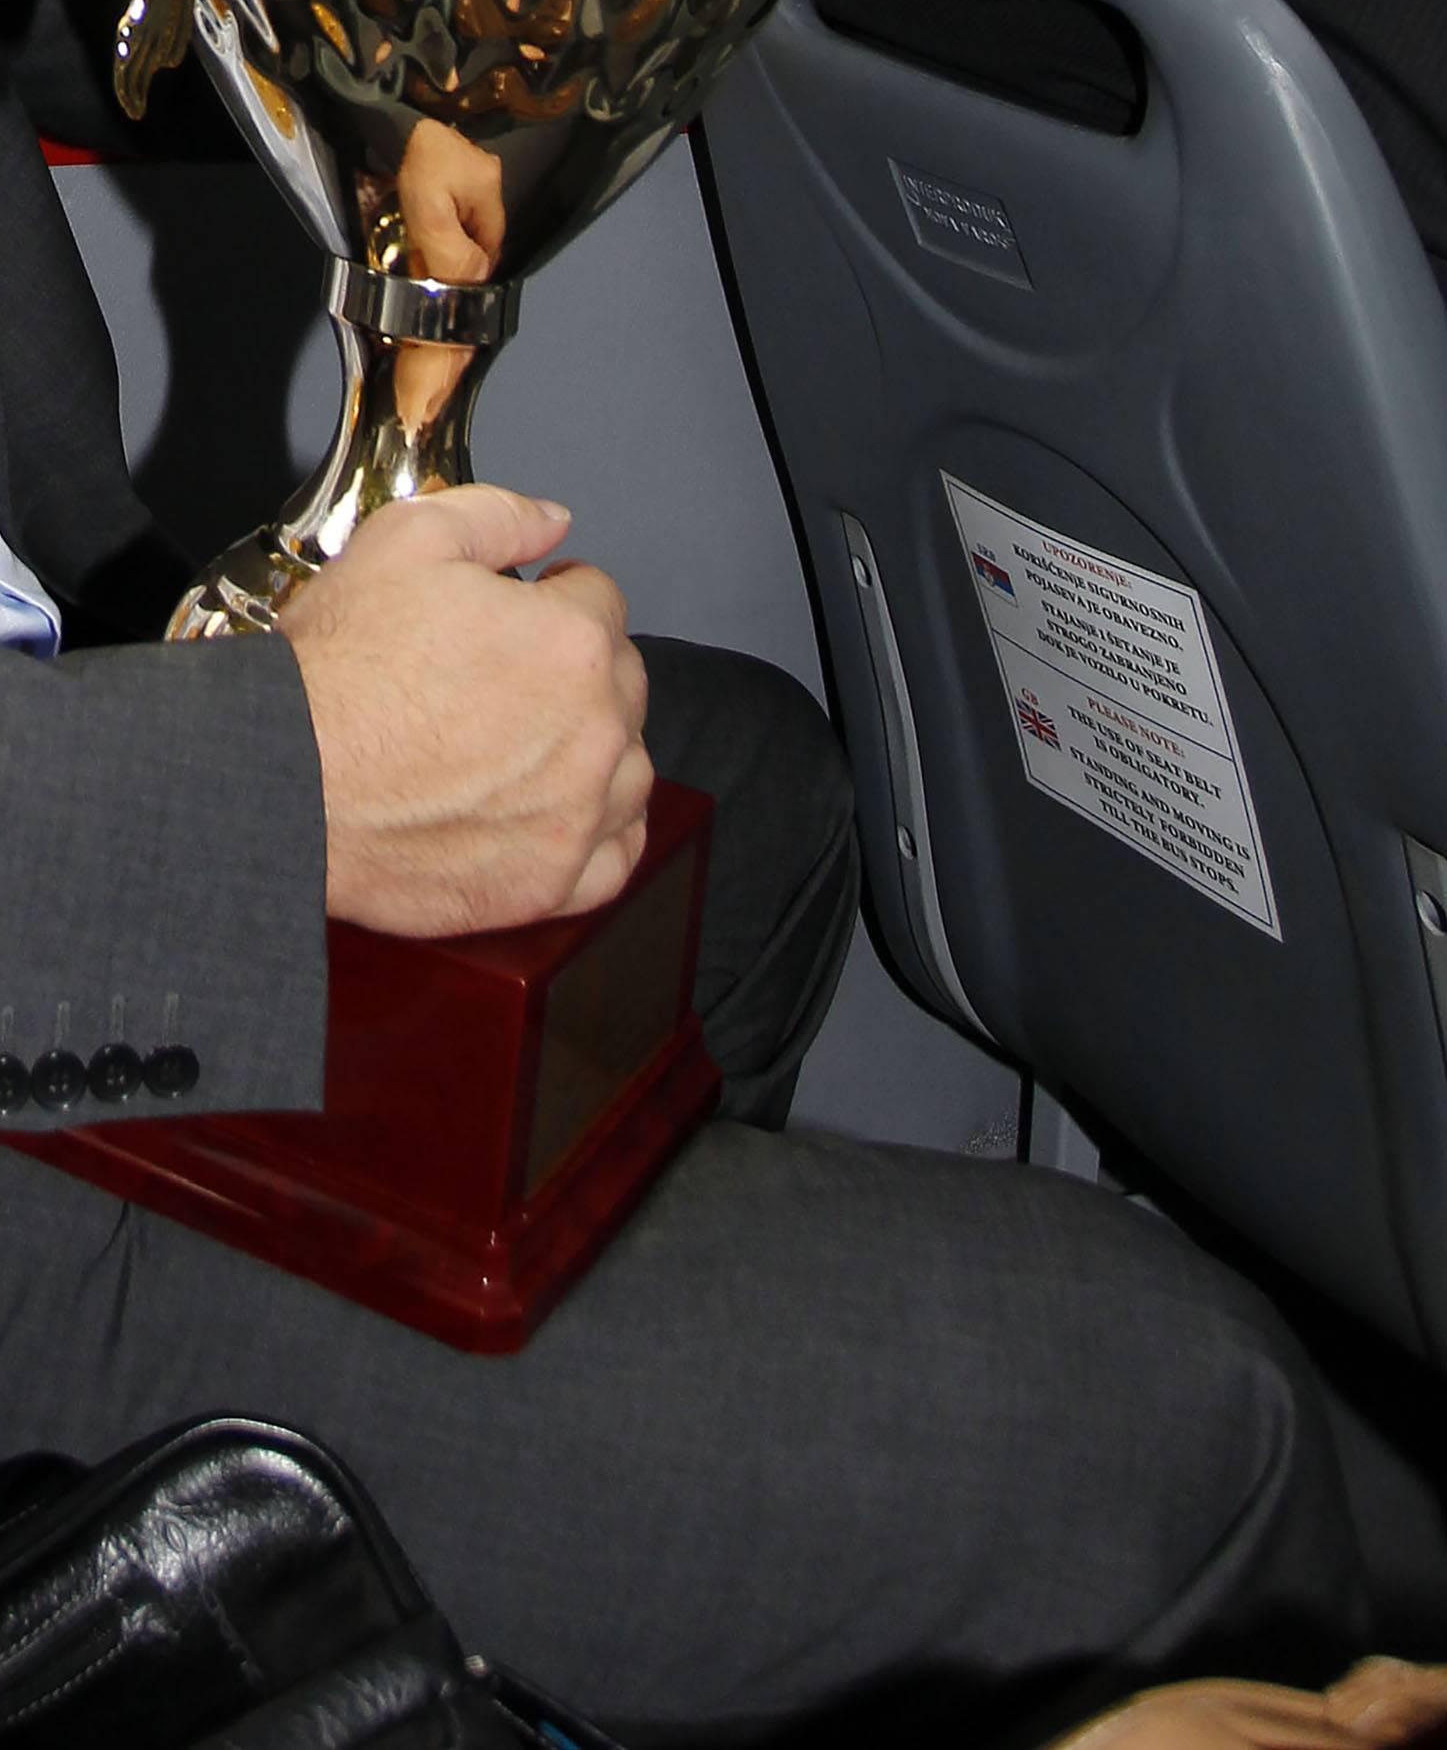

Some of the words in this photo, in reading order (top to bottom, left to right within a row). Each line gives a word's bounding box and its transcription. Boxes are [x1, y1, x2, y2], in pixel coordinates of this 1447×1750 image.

[1025, 568, 1085, 607] POJASEVA
[1084, 597, 1101, 614] JE
[1087, 579, 1184, 631] SIGURNOSNIH
[1046, 618, 1097, 653] STROGO
[1163, 658, 1179, 675] JE
[1021, 687, 1039, 705] GB
[1036, 628, 1065, 652] DOK
[1064, 643, 1081, 661] JE
[1080, 652, 1126, 683] VOZILO
[1128, 676, 1138, 690] U
[1141, 682, 1213, 726] POKRETU.
[1068, 705, 1095, 729] THE
[1097, 722, 1123, 745] USE
[1124, 738, 1145, 757] OF
[1145, 749, 1182, 778] SEAT
[1183, 769, 1223, 800] BELT
[1087, 697, 1137, 733] PLEASE
[1139, 725, 1185, 758] NOTE:
[1070, 745, 1139, 797] STANDING
[1139, 787, 1171, 815] AND
[1172, 806, 1233, 851] MOVING
[1235, 841, 1250, 860] IS
[1093, 735, 1107, 752] IS
[1108, 744, 1205, 808] OBLIGATORY.
[1084, 772, 1154, 824] STRICTELY
[1159, 817, 1245, 878] FORBIDDEN
[1099, 798, 1130, 826] TILL
[1129, 817, 1159, 845] THE
[1160, 836, 1187, 862] BUS
[1189, 854, 1238, 894] STOPS.
